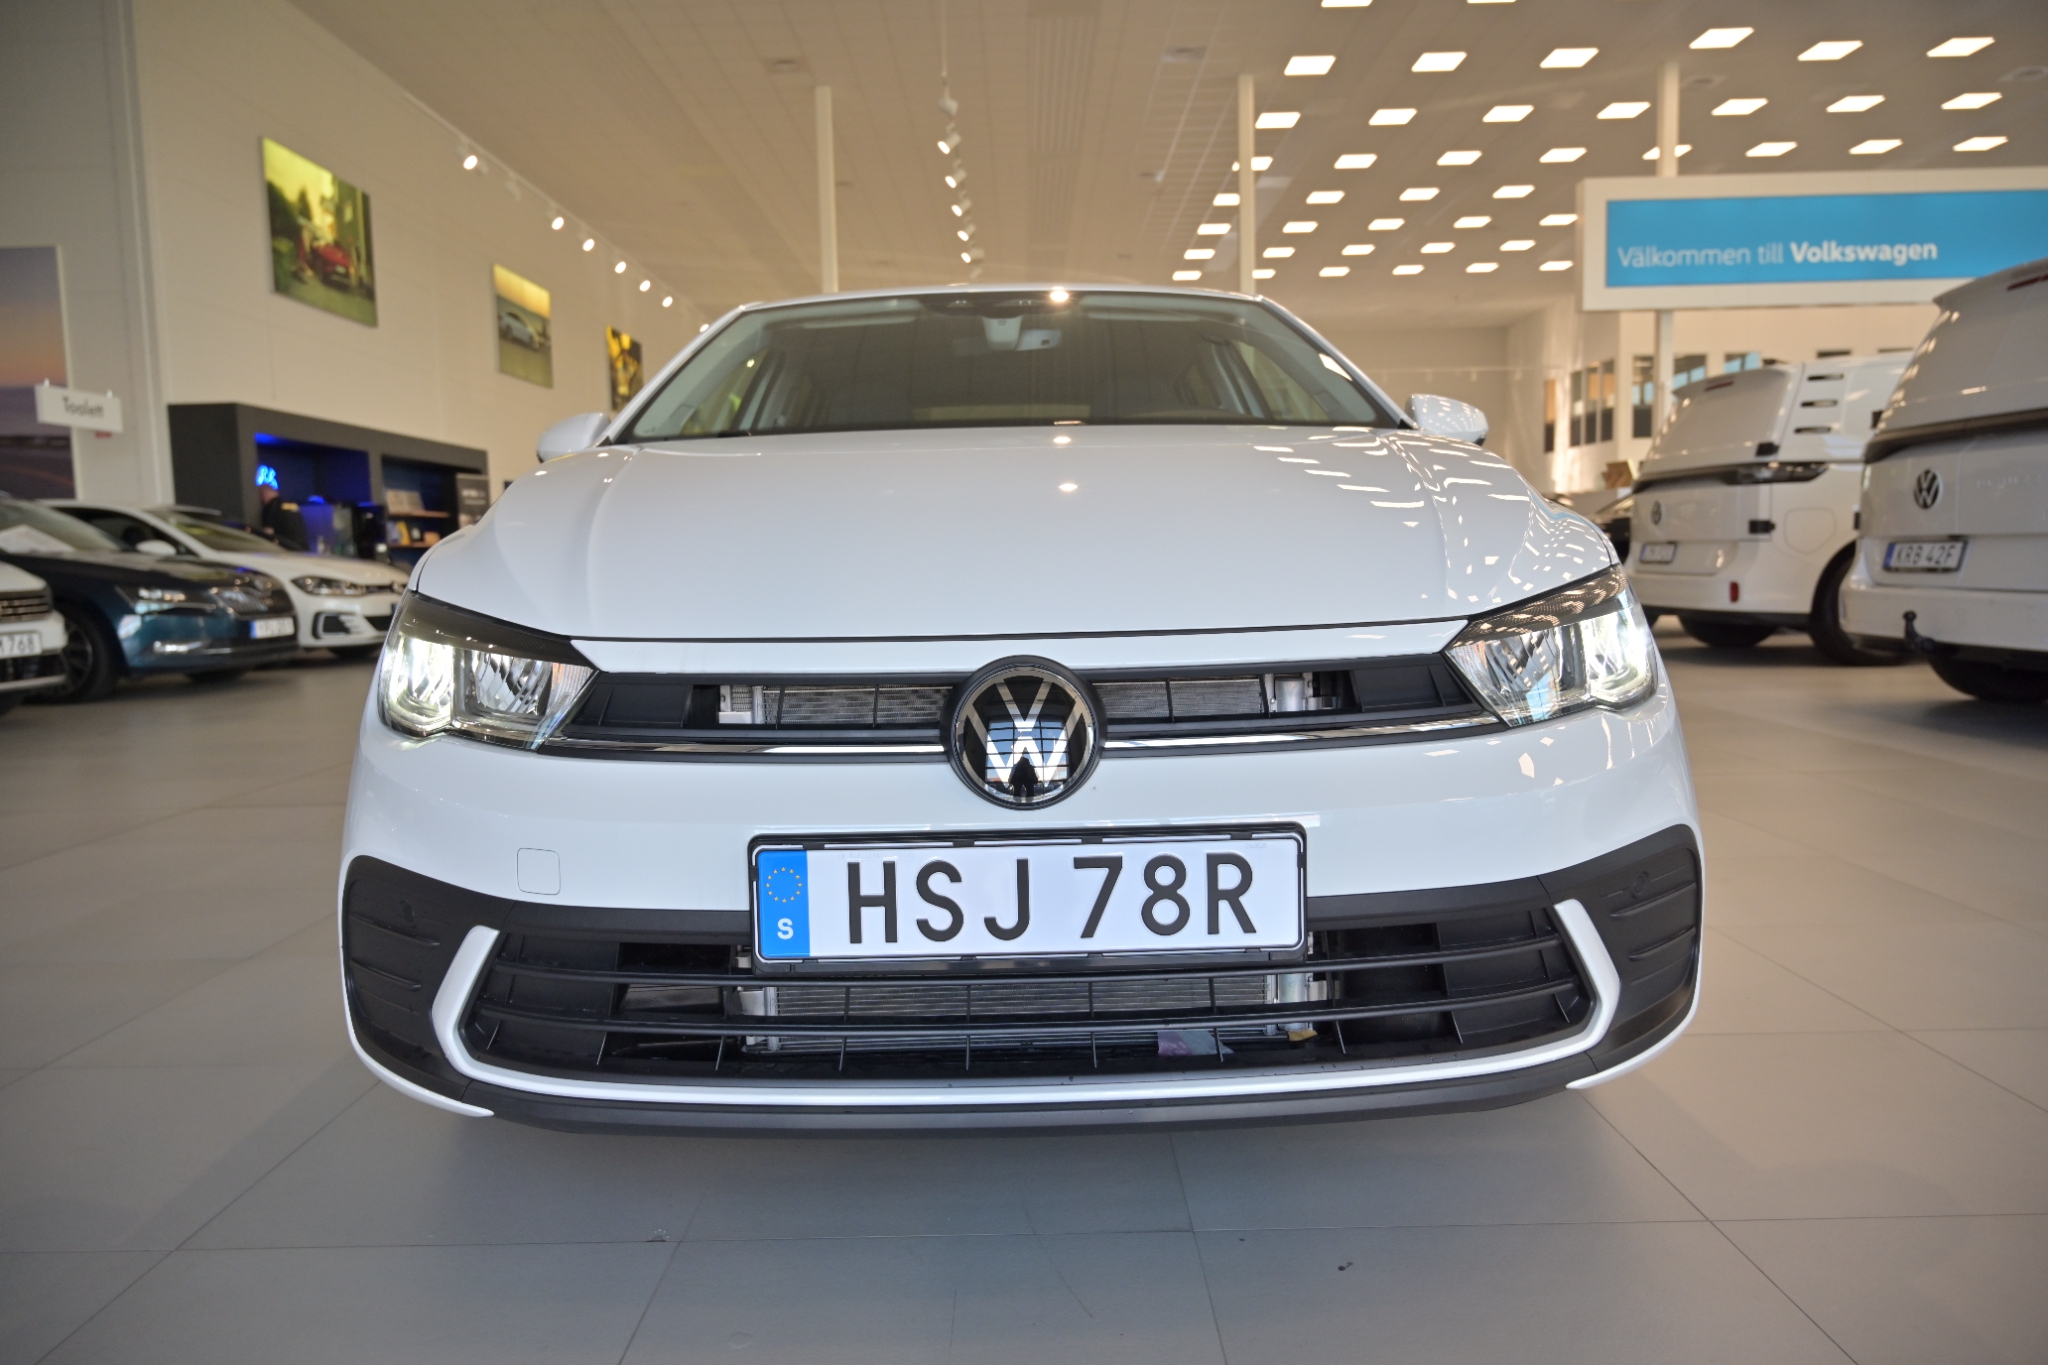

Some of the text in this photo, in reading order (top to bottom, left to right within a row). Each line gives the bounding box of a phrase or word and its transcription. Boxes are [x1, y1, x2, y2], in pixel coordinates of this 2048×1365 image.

[1617, 240, 1937, 267] Välkommen till Volkswagen
[962, 672, 1089, 796] VW
[847, 852, 1256, 943] HSJ 78R
[777, 918, 794, 940] S
